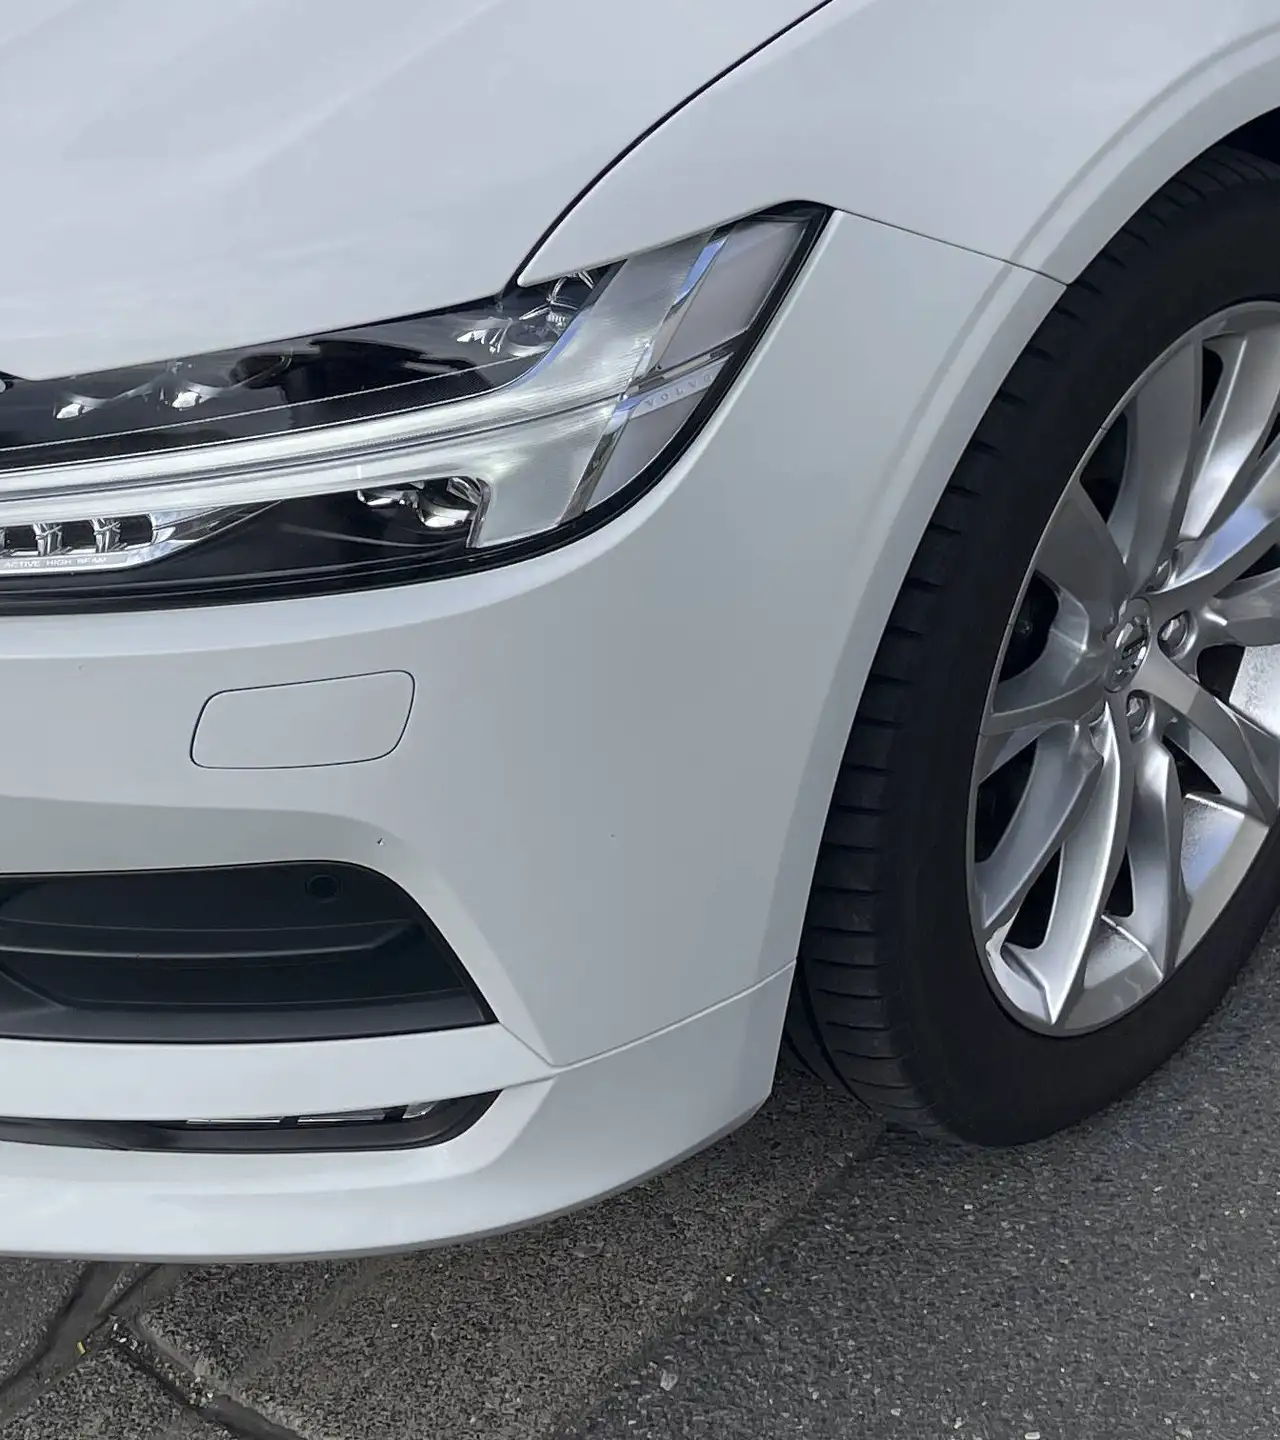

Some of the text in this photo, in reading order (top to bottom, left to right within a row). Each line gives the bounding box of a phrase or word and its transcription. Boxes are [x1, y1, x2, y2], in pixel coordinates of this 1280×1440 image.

[644, 374, 713, 407] VOLVO
[3, 560, 41, 569] ACTIVE
[46, 558, 73, 567] HIGH
